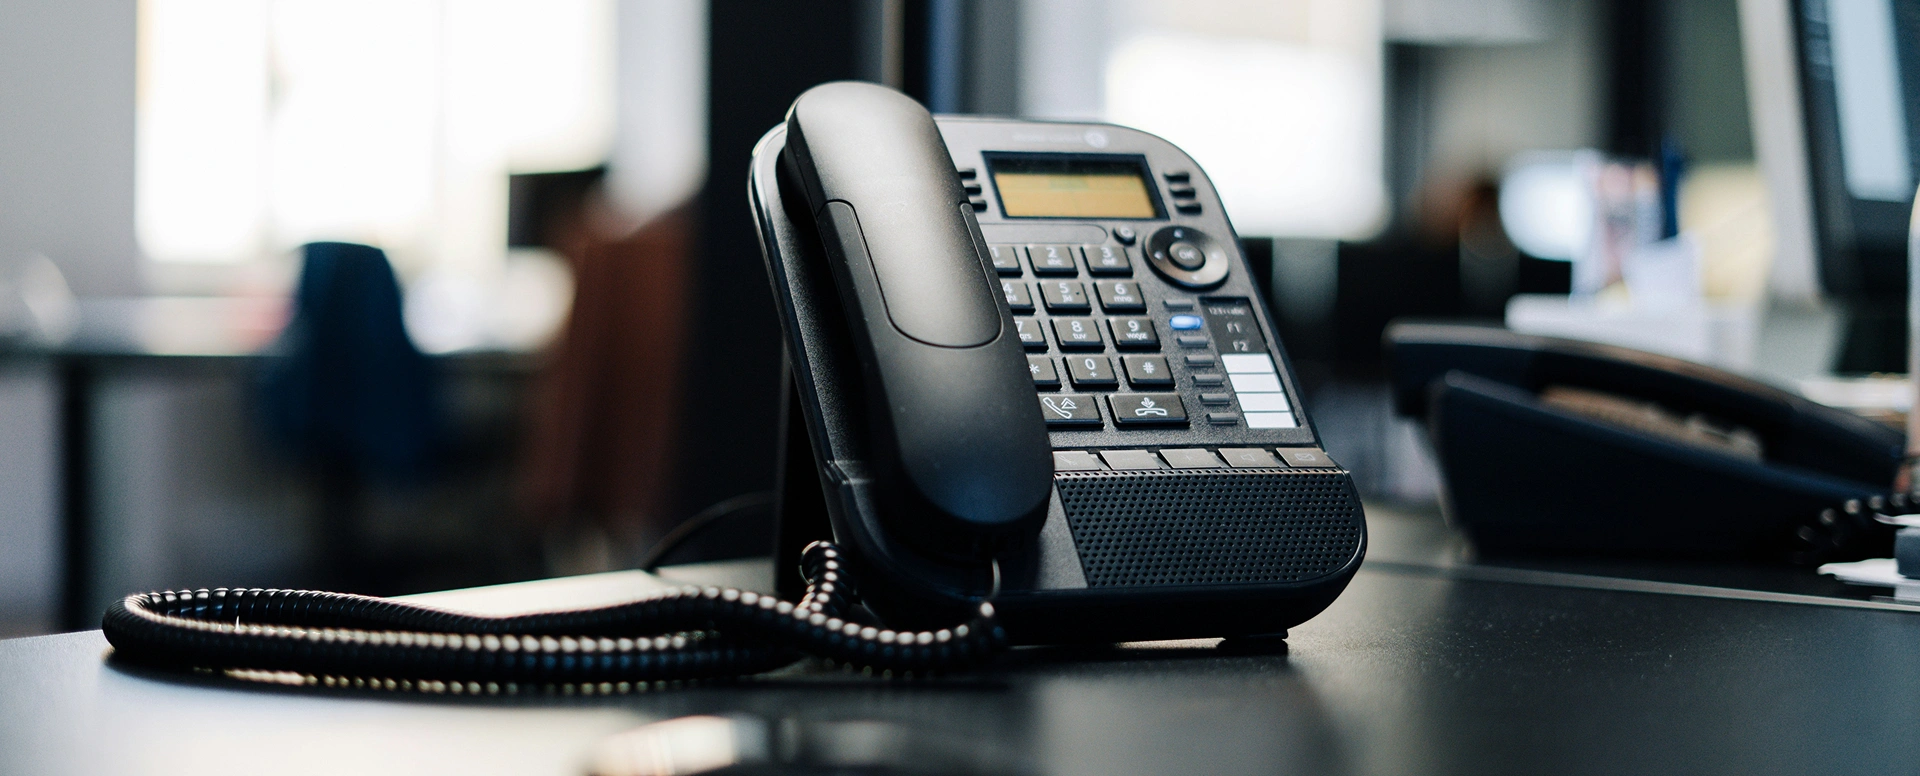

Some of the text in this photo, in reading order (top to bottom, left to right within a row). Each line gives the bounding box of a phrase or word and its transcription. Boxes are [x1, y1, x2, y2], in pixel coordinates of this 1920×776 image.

[991, 247, 999, 258] 1
[1046, 246, 1058, 258] 2
[1101, 247, 1112, 258] 3
[1178, 249, 1196, 260] OK
[1003, 283, 1013, 294] 4
[1059, 283, 1069, 294] 5
[1114, 283, 1126, 294] 6
[1113, 295, 1133, 303] mno
[1015, 321, 1024, 332] 7
[1071, 321, 1083, 332] 8
[1127, 320, 1140, 332] 9
[1226, 322, 1241, 333] F1
[1019, 333, 1032, 341] qrs
[1072, 332, 1087, 340] tuv
[1126, 332, 1148, 340] wxyz
[1232, 341, 1248, 352] F2
[1085, 358, 1096, 371] 0
[1142, 362, 1155, 374] #
